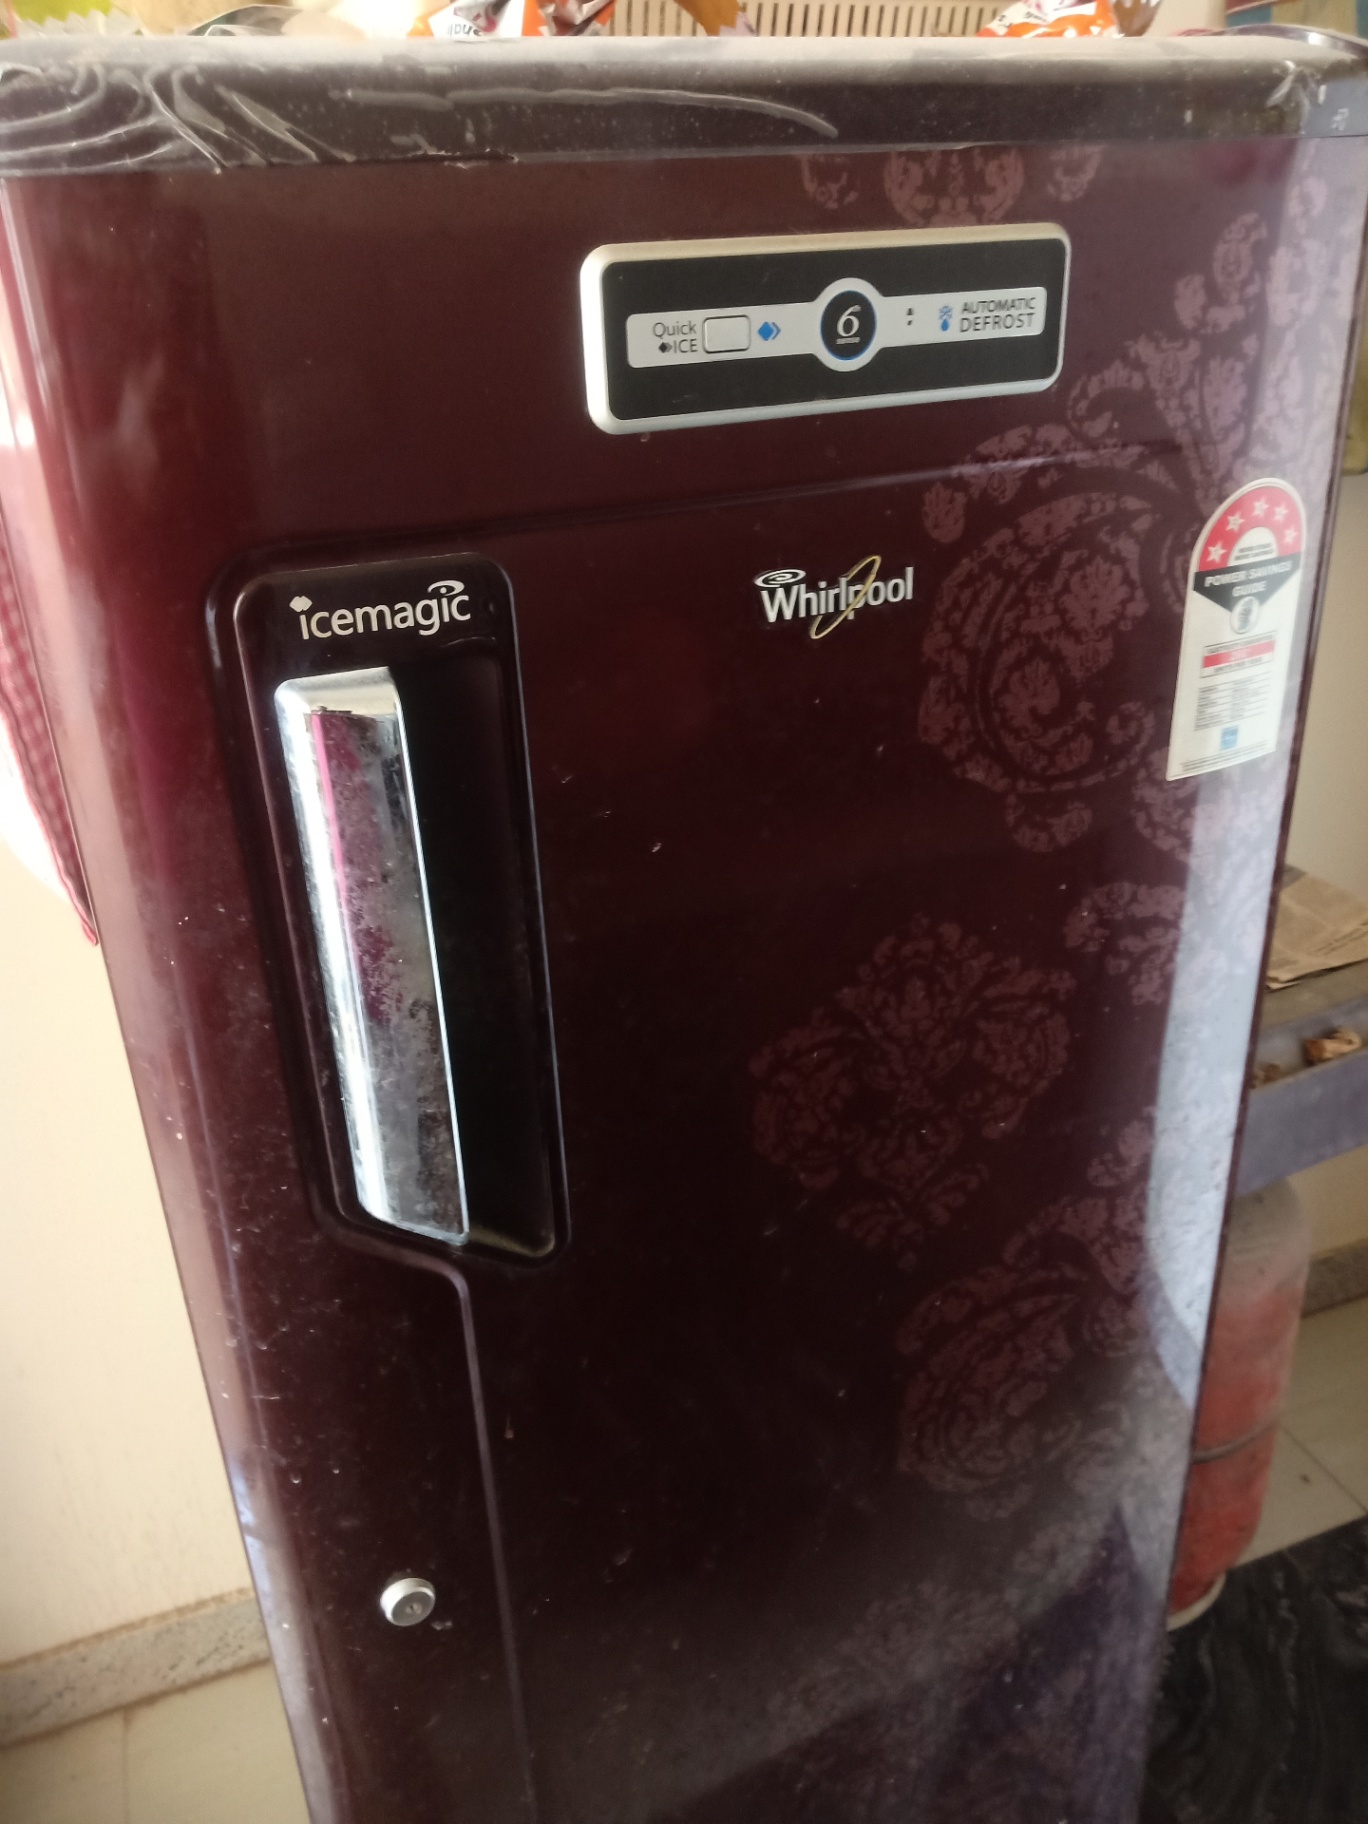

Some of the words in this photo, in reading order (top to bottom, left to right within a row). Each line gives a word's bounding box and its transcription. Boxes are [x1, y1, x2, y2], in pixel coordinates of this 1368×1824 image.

[962, 297, 1036, 314] AUTOMATIC
[653, 320, 697, 339] Quick
[960, 312, 1035, 333] DEFROST
[673, 339, 698, 353] ICE
[758, 564, 914, 624] Whirlpool
[289, 580, 471, 640] icemagic
